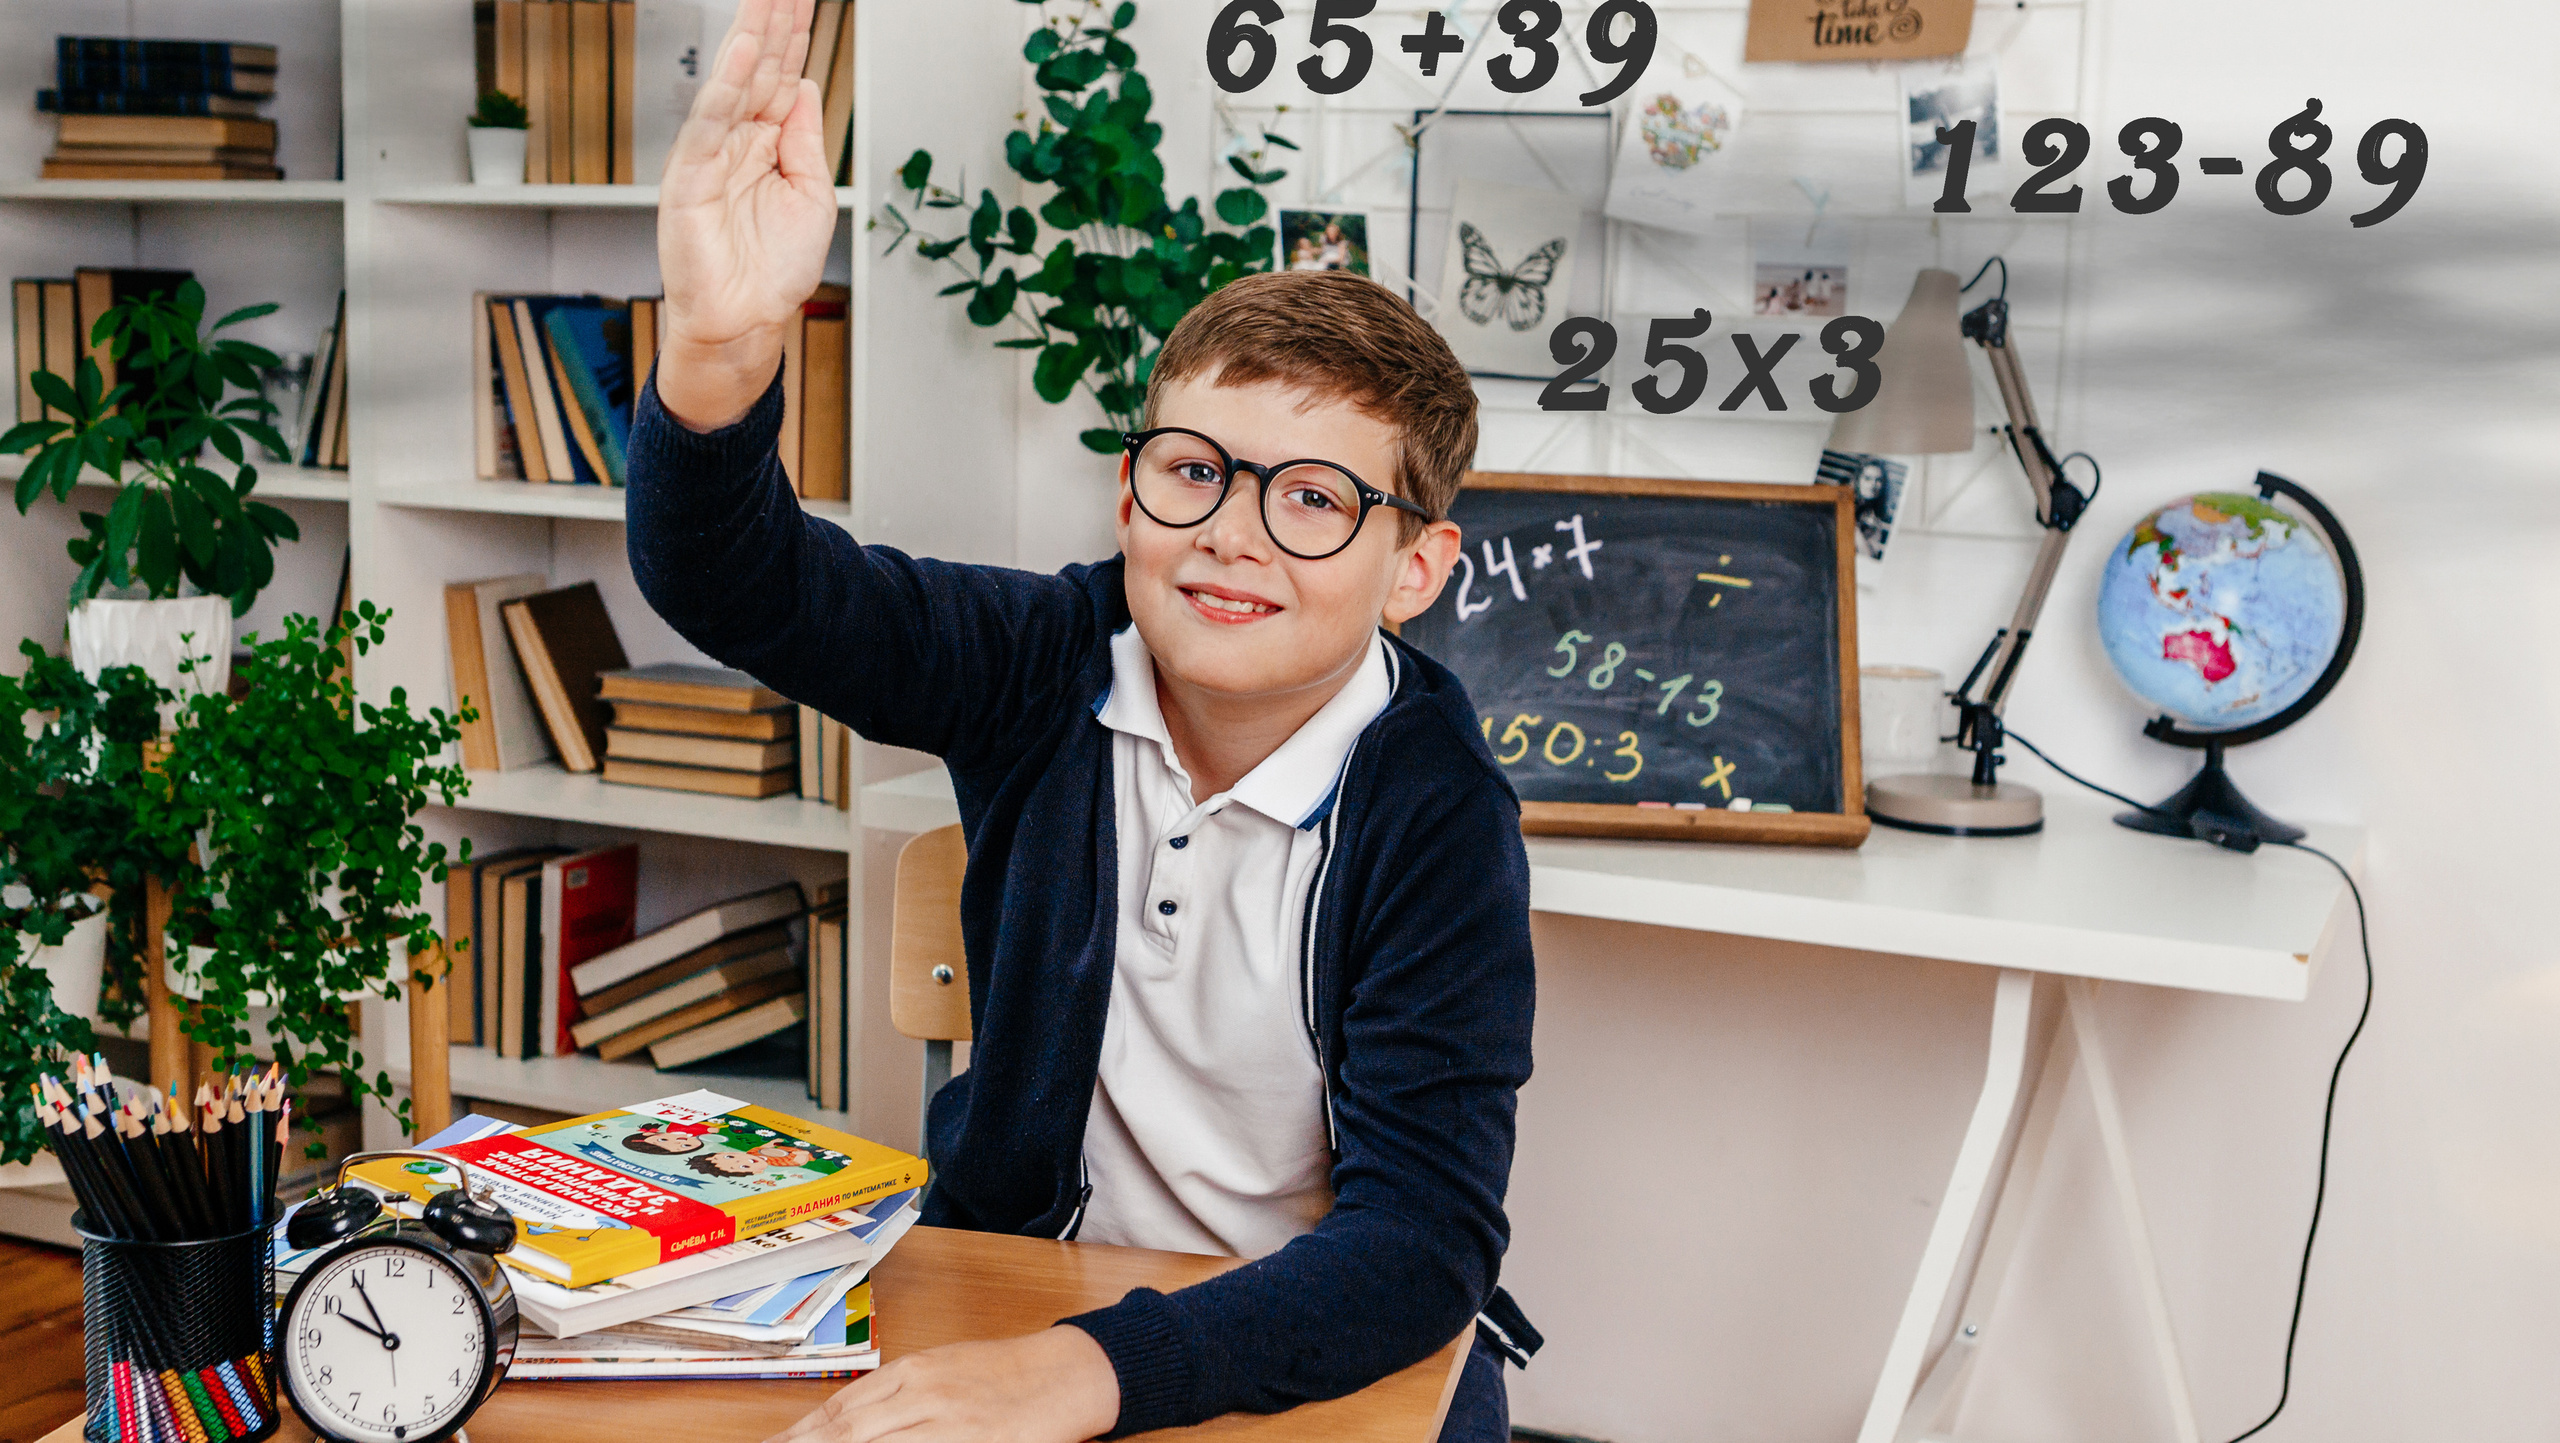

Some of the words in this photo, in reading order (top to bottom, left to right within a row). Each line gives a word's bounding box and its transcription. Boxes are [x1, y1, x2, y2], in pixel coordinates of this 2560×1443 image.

[1807, 10, 1883, 46] time
[1547, 629, 1724, 727] 58-13
[488, 1150, 642, 1208] ОЛИМПИАДНЫЕ
[516, 1148, 679, 1207] ЗАДАНИЯ
[475, 1159, 638, 1218] НЕСТАНДАРТНЫЕ
[790, 1194, 841, 1218] ЗАДАНИЯ
[842, 1191, 852, 1200] ПО
[852, 1178, 898, 1199] МАТЕМАТИКЕ
[639, 1205, 664, 1216] И
[670, 1235, 707, 1253] СЫЧЁВА
[709, 1228, 727, 1242] Г.Н.
[384, 1257, 405, 1278] 12
[426, 1269, 435, 1289] 1
[322, 1295, 342, 1315] 10
[452, 1295, 465, 1315] 2
[308, 1328, 322, 1349] 9
[463, 1332, 476, 1352] 3
[319, 1365, 332, 1386] 8
[448, 1368, 462, 1387] 4
[348, 1392, 361, 1412] 7
[422, 1396, 435, 1415] 5
[383, 1403, 397, 1424] 6
